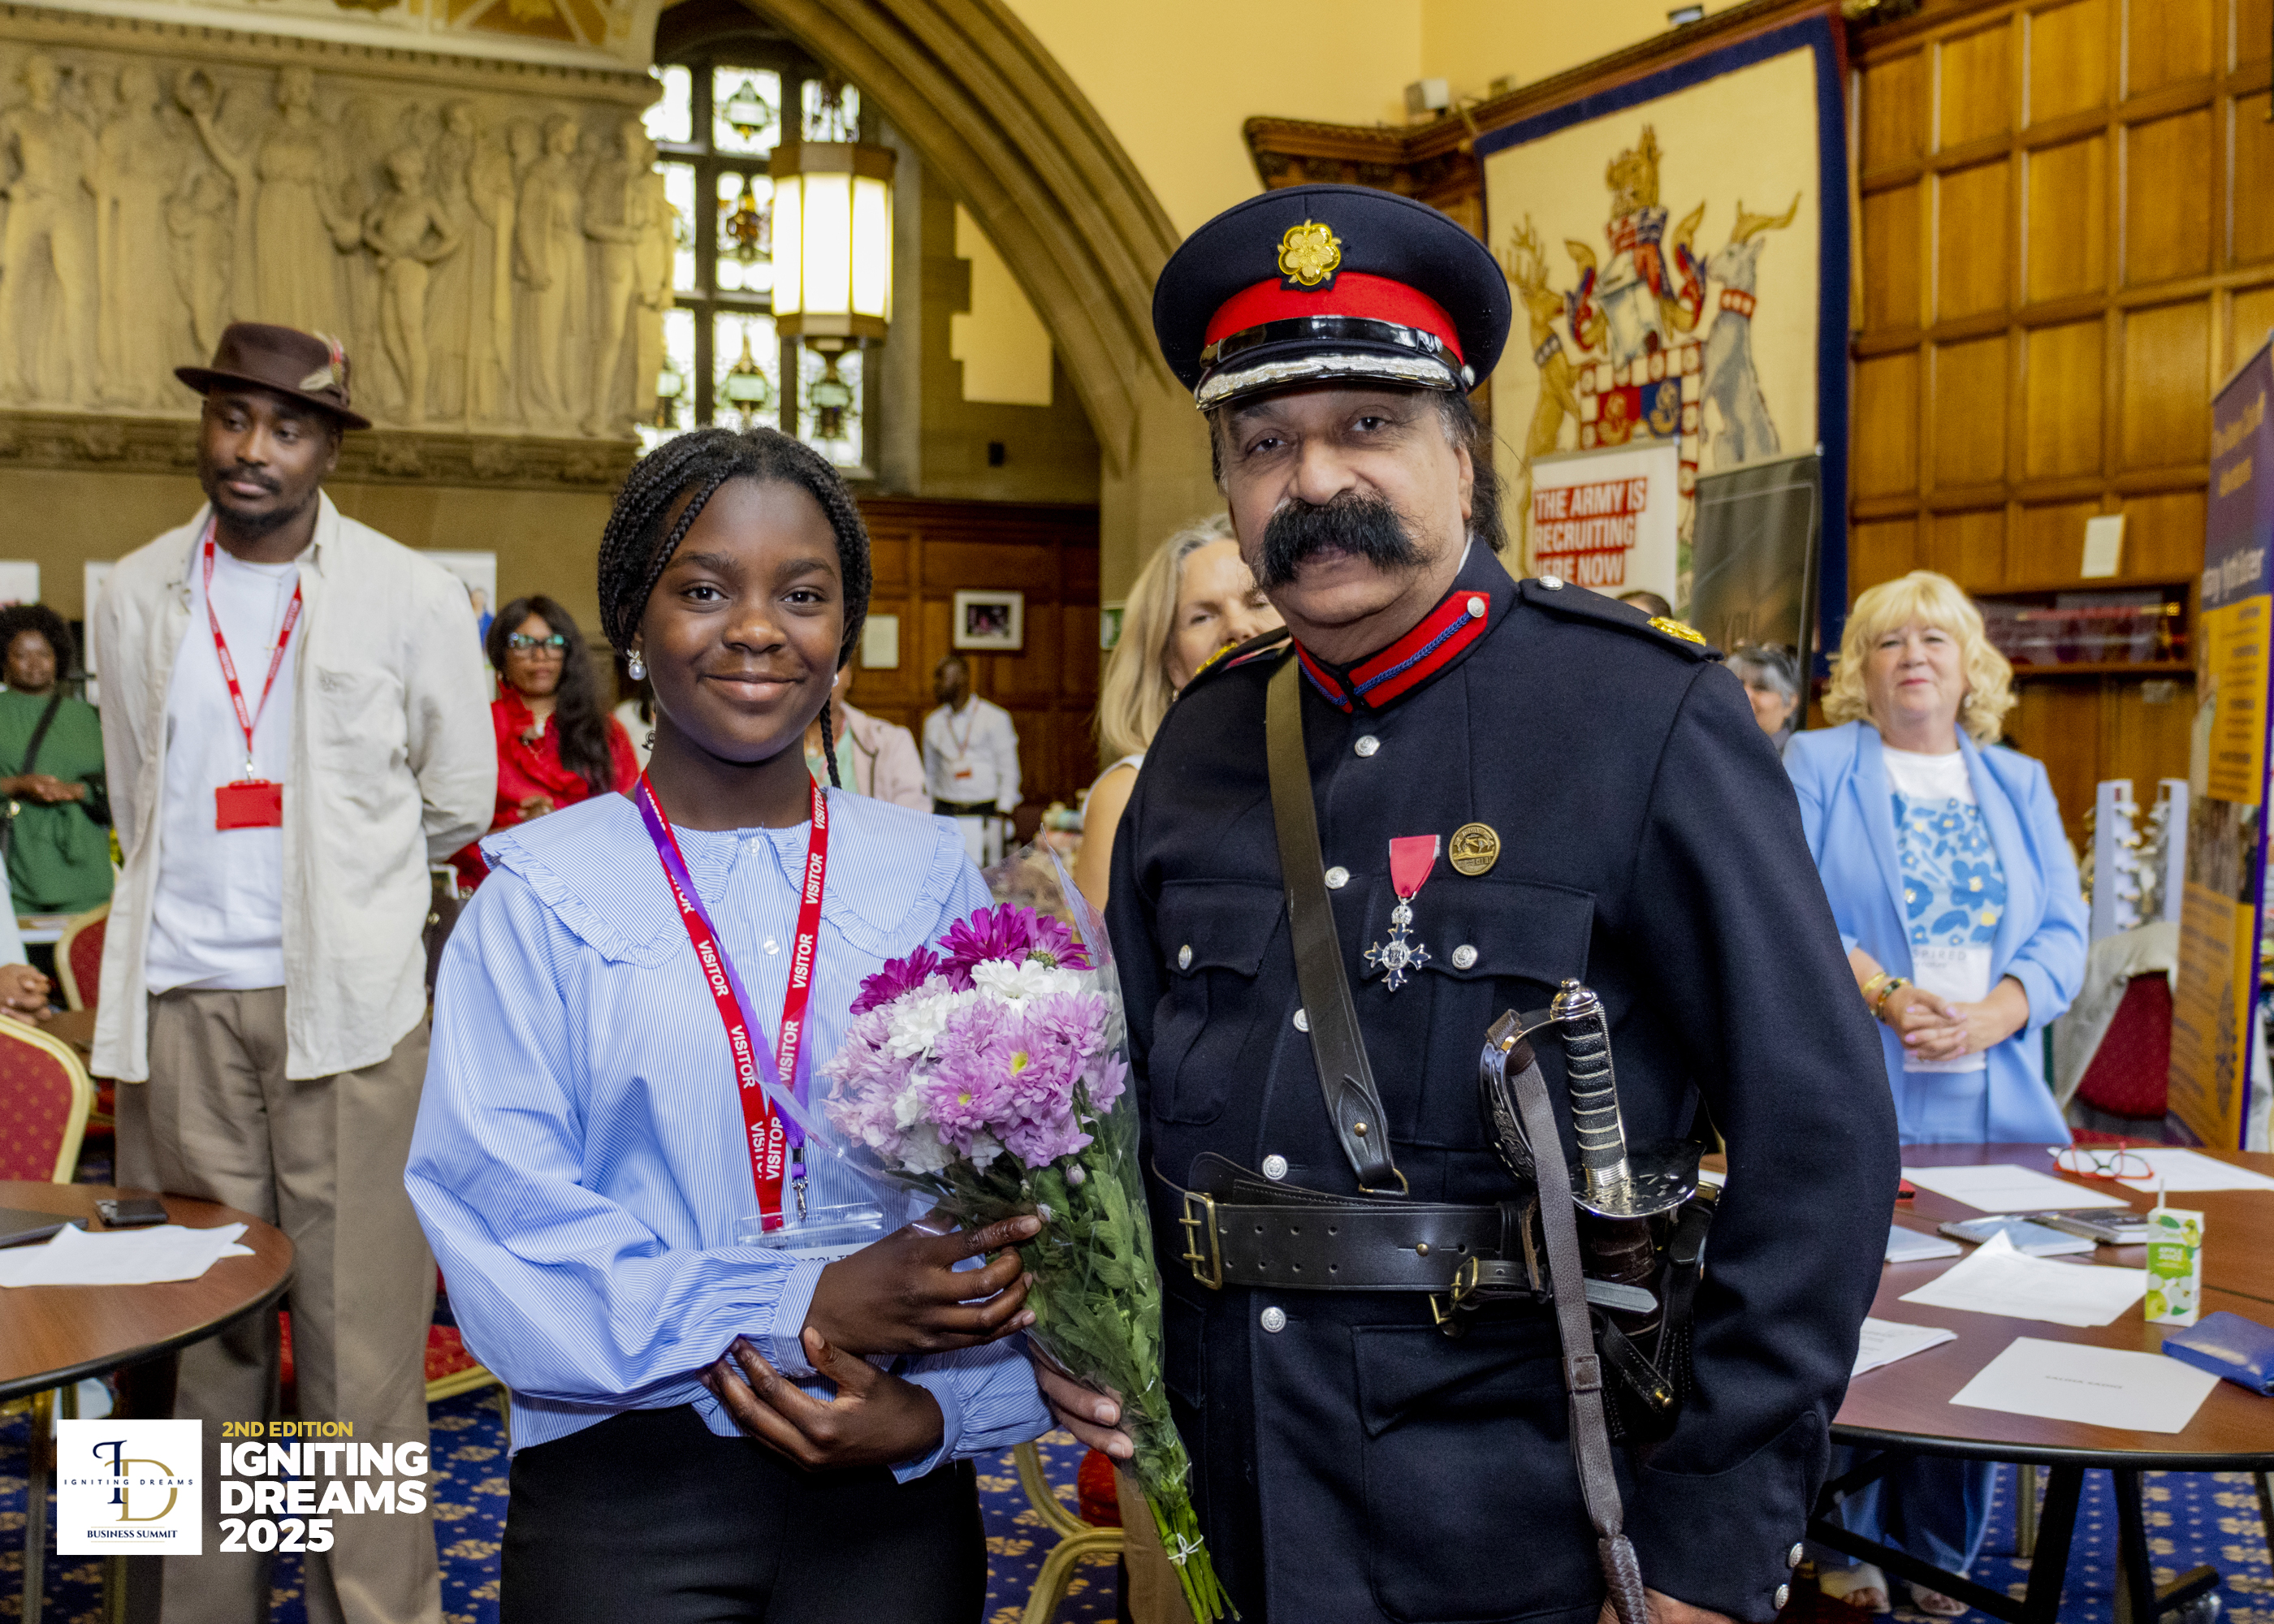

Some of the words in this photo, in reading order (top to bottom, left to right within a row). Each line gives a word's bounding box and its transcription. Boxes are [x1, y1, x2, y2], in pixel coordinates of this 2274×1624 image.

[1535, 490, 1567, 520] THE
[1569, 482, 1624, 516] ARMY
[1626, 478, 1645, 511] IS
[1534, 515, 1635, 552] RECRUITING
[1577, 554, 1624, 585] NOW
[284, 599, 300, 632] VISITOR
[219, 647, 236, 680] VISITOR
[814, 787, 826, 831] VISITOR
[806, 853, 824, 905] VISITOR
[698, 939, 729, 997] VISITOR
[793, 934, 814, 989] VISITOR
[731, 1025, 756, 1089] VISITOR
[780, 1020, 799, 1082] VISITOR
[750, 1121, 766, 1179] VISI
[766, 1116, 784, 1181] VISITOR
